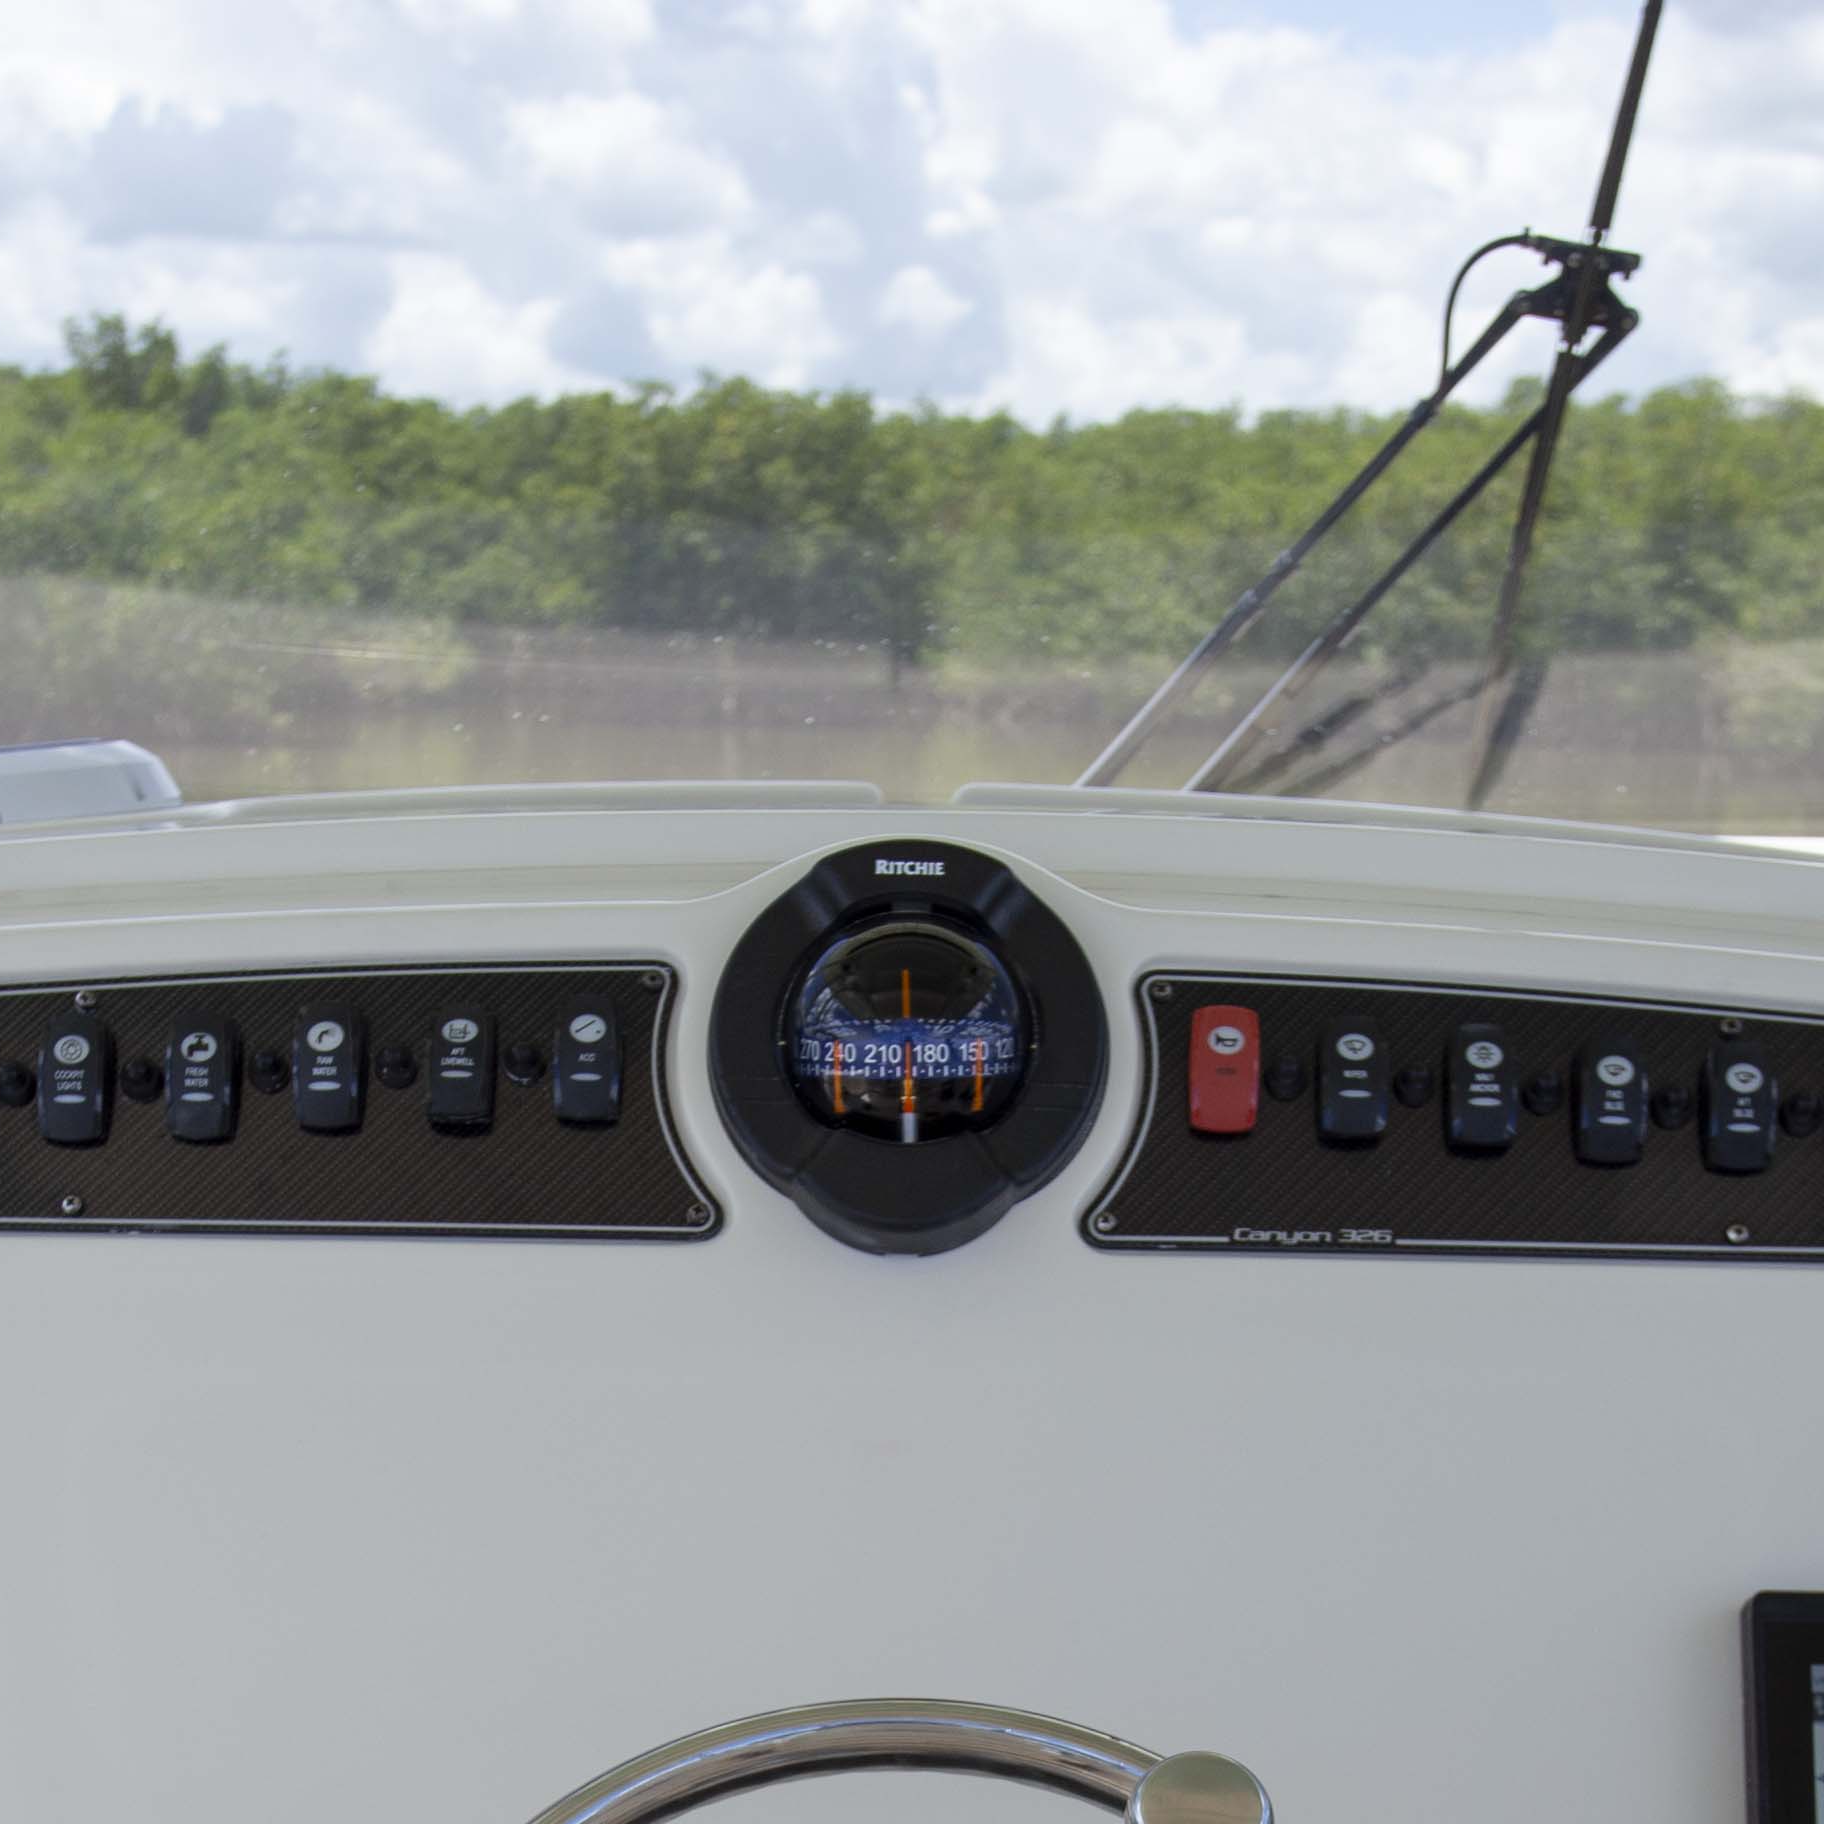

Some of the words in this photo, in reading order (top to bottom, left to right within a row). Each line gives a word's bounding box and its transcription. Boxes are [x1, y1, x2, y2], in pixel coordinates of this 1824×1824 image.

[875, 859, 945, 876] RITCHIE
[824, 1041, 856, 1063] 240
[863, 1042, 902, 1063] 210
[912, 1043, 950, 1063] 180
[959, 1041, 989, 1062] 150
[54, 1069, 86, 1080] COCKPIT
[184, 1066, 210, 1077] FRESH
[312, 1066, 337, 1077] WATER
[56, 1080, 82, 1091] LIGHTS
[184, 1077, 209, 1088] WATER
[1233, 1227, 1332, 1245] Canyon
[1338, 1228, 1393, 1244] 326
